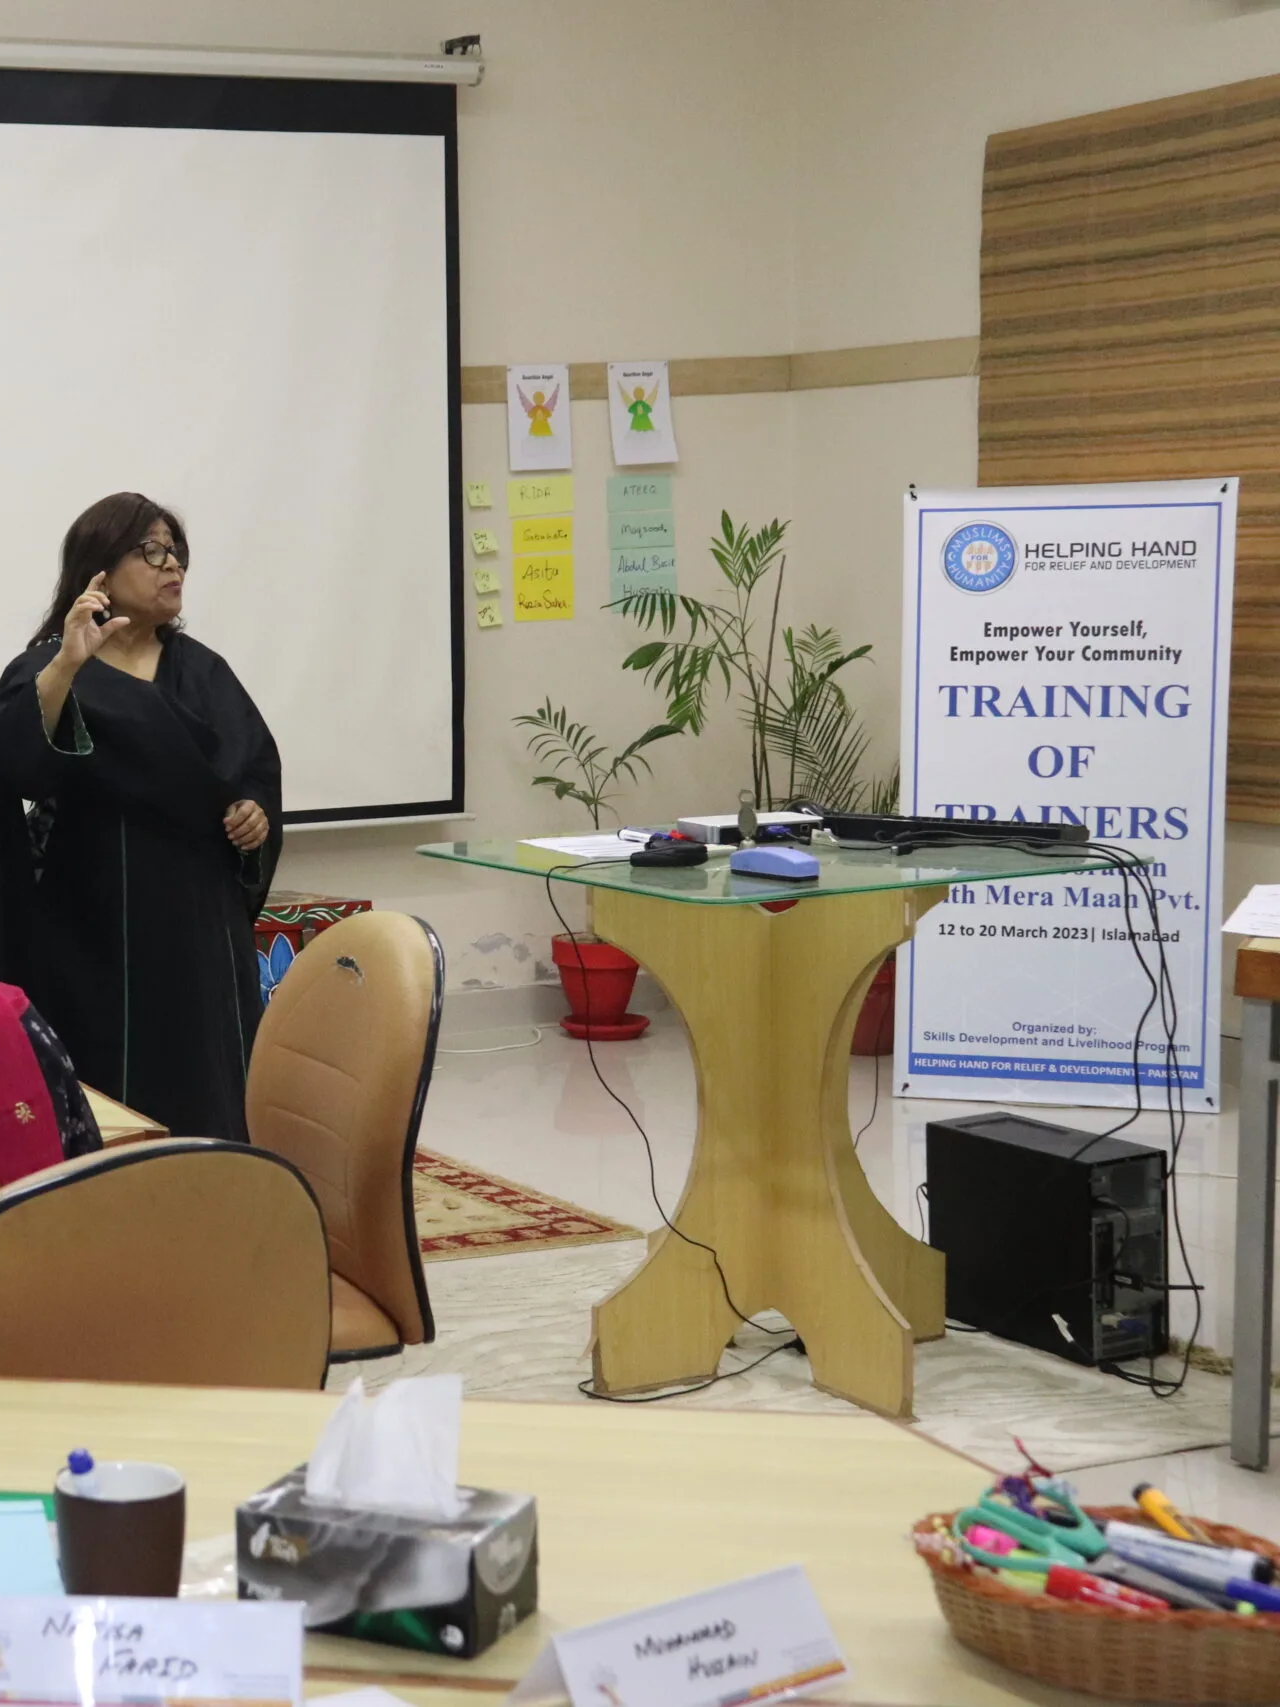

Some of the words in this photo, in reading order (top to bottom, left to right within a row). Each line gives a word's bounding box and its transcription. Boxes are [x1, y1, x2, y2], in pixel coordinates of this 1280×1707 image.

[951, 526, 1011, 553] MUSLIMS
[1024, 541, 1122, 559] HELPING
[1131, 540, 1197, 556] HAND
[948, 562, 1011, 588] HUMANITY
[1024, 561, 1046, 571] FOR
[1048, 560, 1087, 571] RELIEF
[1089, 560, 1113, 570] AND
[1115, 559, 1197, 570] DEVELOPMENT
[983, 621, 1063, 641] Empower
[1070, 620, 1148, 639] Yourself,
[949, 646, 1028, 665] Empower
[1035, 645, 1075, 662] Your
[1081, 644, 1183, 665] Community
[938, 684, 1192, 719] TRAINING
[1027, 745, 1096, 779] OF
[985, 885, 1054, 907] Mera
[1063, 886, 1139, 909] Maan
[1151, 888, 1201, 910] Pvt.
[938, 923, 955, 936] 12
[960, 926, 975, 937] to
[979, 925, 997, 937] 20
[1000, 925, 1048, 939] March
[1101, 928, 1180, 943] Islamabad
[1012, 1021, 1075, 1036] Organized
[1078, 1024, 1097, 1037] by:
[923, 1031, 956, 1043] Skills
[959, 1032, 1038, 1047] Development
[1041, 1036, 1064, 1047] and
[1068, 1037, 1132, 1050] Livelihood
[1135, 1040, 1191, 1054] Program
[914, 1057, 957, 1069] HELPING
[959, 1059, 989, 1070] HAND
[991, 1061, 1012, 1071] FOR
[1014, 1062, 1047, 1073] RELIEF
[1048, 1063, 1058, 1073] &
[1060, 1065, 1136, 1077] DEVELOPMENT
[1148, 1069, 1199, 1081] PAKSTAN
